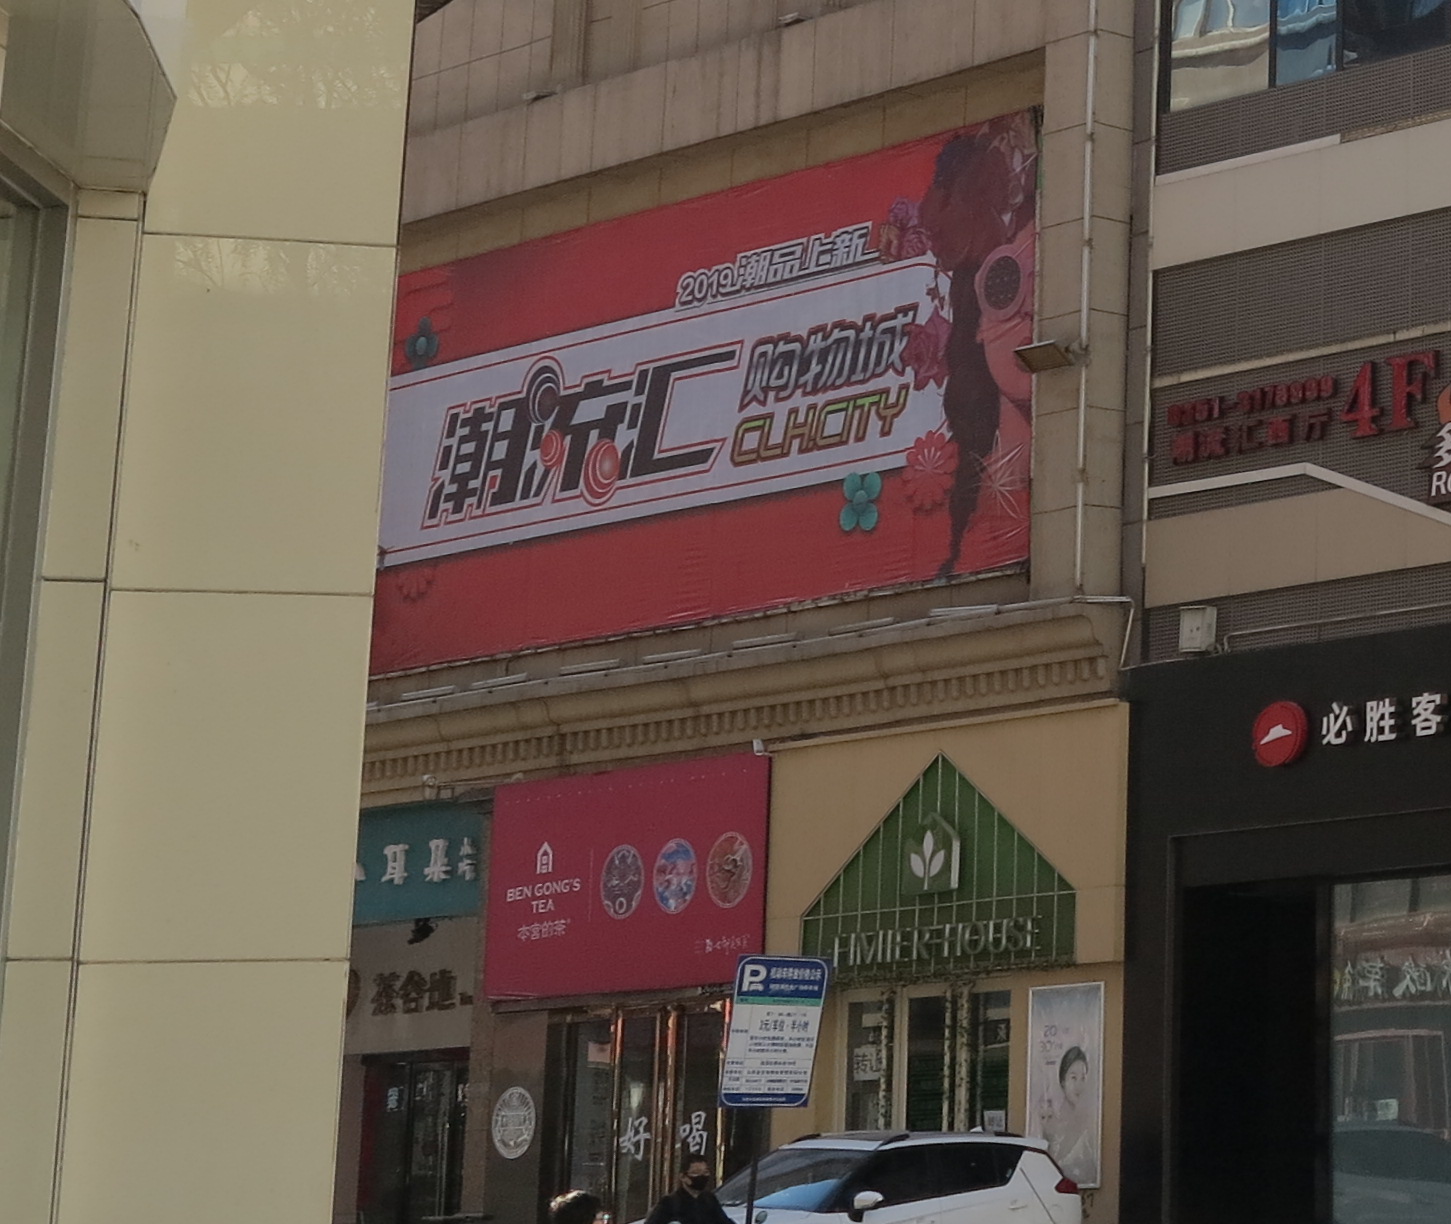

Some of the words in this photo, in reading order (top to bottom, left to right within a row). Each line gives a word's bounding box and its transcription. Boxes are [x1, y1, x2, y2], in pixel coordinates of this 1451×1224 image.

[675, 222, 879, 311] 2019潮品上新
[739, 304, 920, 412] 购物城
[1320, 690, 1446, 747] 必胜客
[506, 886, 532, 903] BEN
[533, 878, 582, 899] GONG'S
[531, 897, 555, 914] TEA
